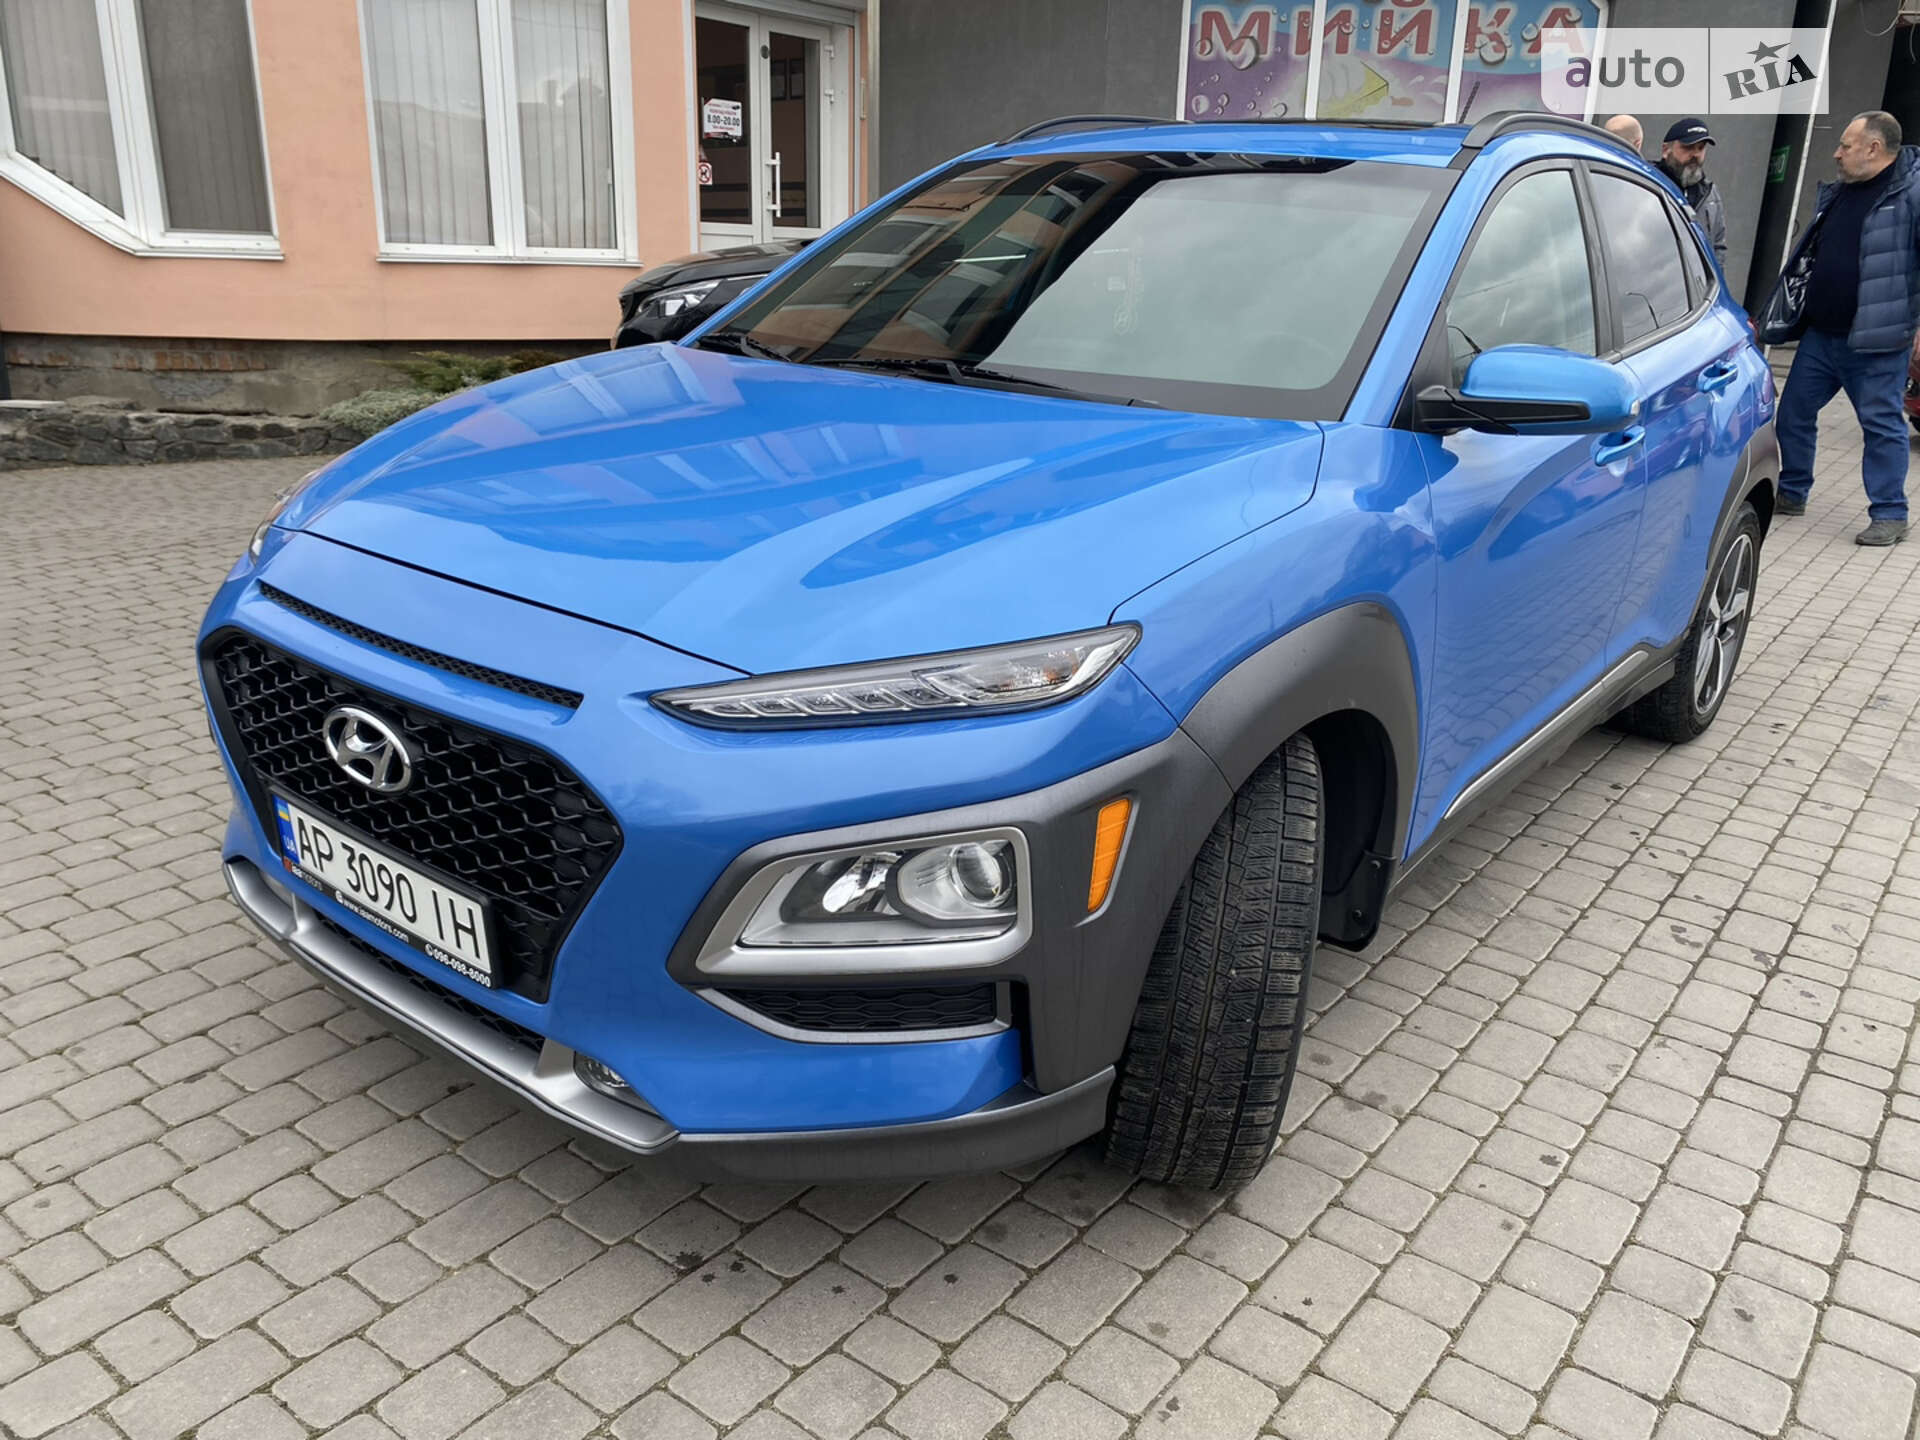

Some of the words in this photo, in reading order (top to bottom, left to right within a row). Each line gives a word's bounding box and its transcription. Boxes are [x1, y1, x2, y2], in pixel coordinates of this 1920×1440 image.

[1199, 0, 1586, 55] МИЙКА
[297, 816, 334, 873] AP
[341, 841, 417, 924] 3090
[432, 888, 481, 960] IH
